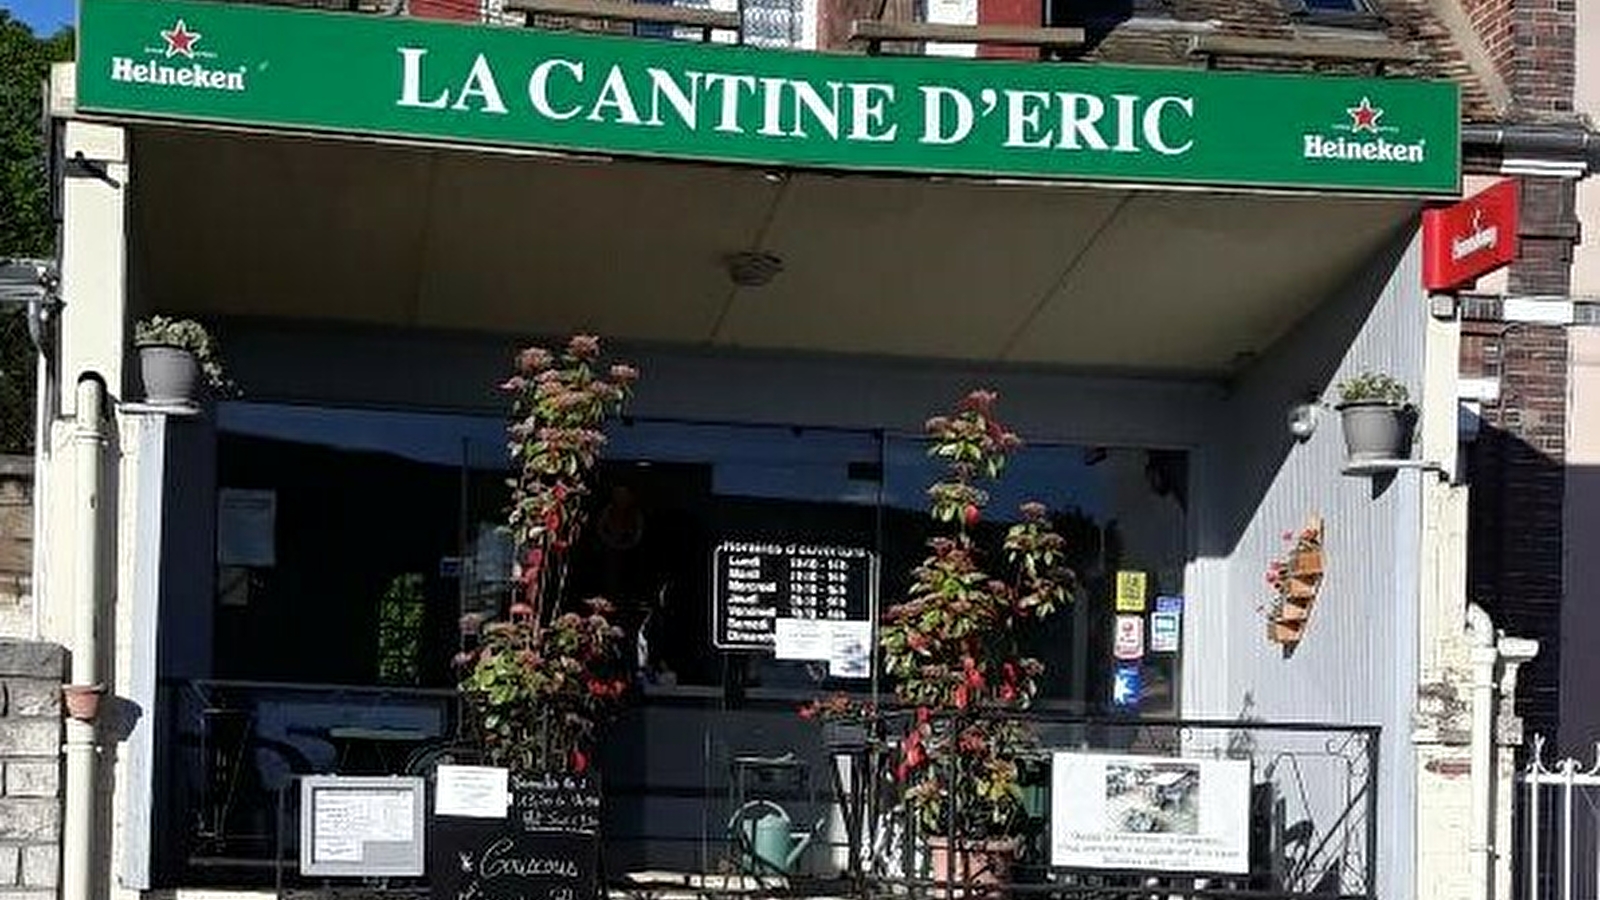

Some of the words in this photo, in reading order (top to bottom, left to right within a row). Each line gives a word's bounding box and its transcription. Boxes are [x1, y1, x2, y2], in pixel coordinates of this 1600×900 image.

[111, 56, 245, 90] Heineken
[396, 47, 508, 114] LA
[528, 58, 898, 142] CANTINE
[1304, 134, 1425, 162] Heineken
